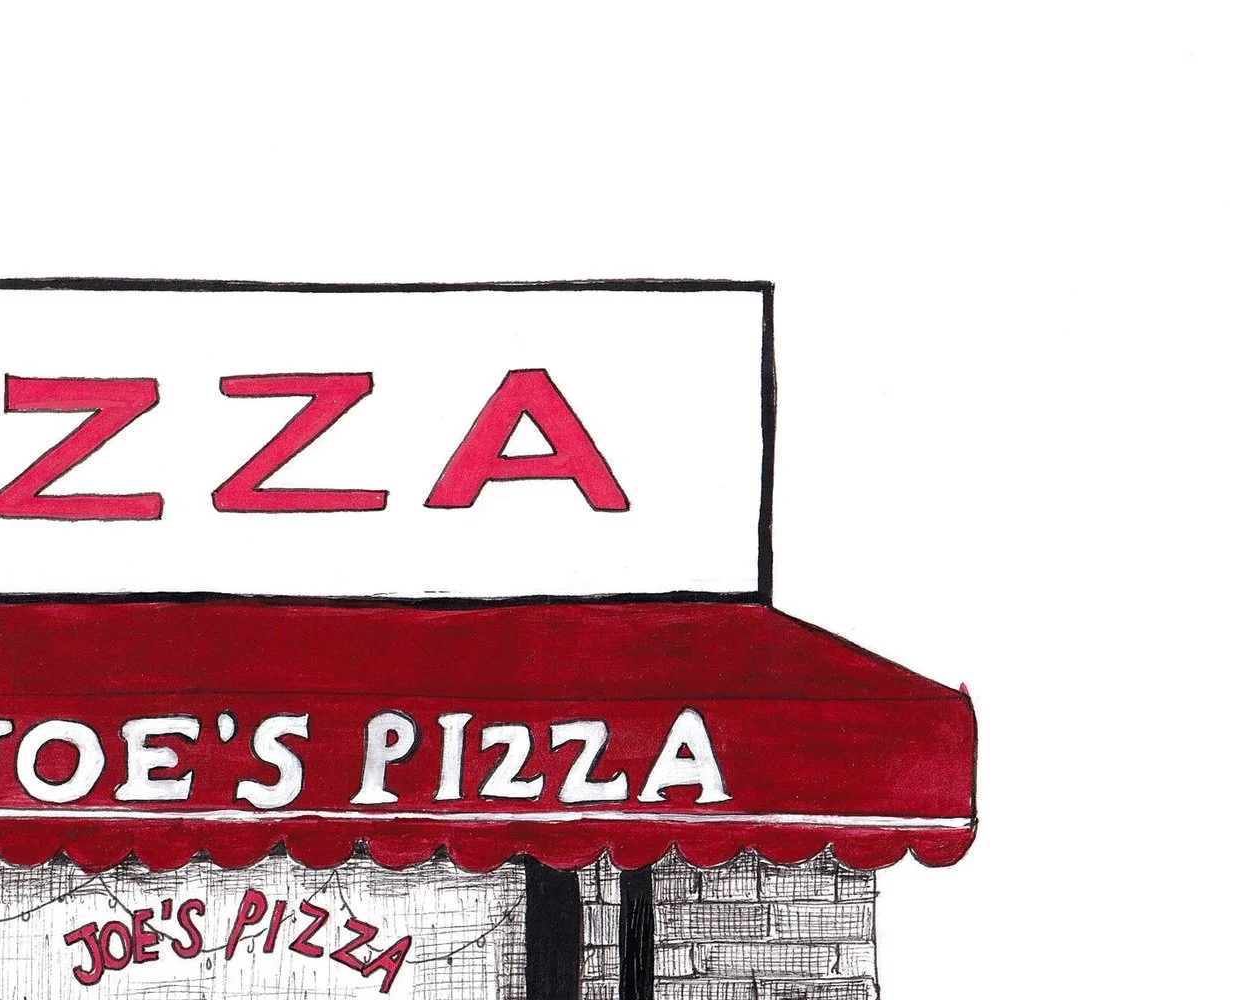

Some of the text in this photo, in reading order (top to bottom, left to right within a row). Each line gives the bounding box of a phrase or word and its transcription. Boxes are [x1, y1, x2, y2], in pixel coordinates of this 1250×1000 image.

[350, 709, 732, 806] PIZZA
[63, 888, 413, 993] JOE'S PIZZA
